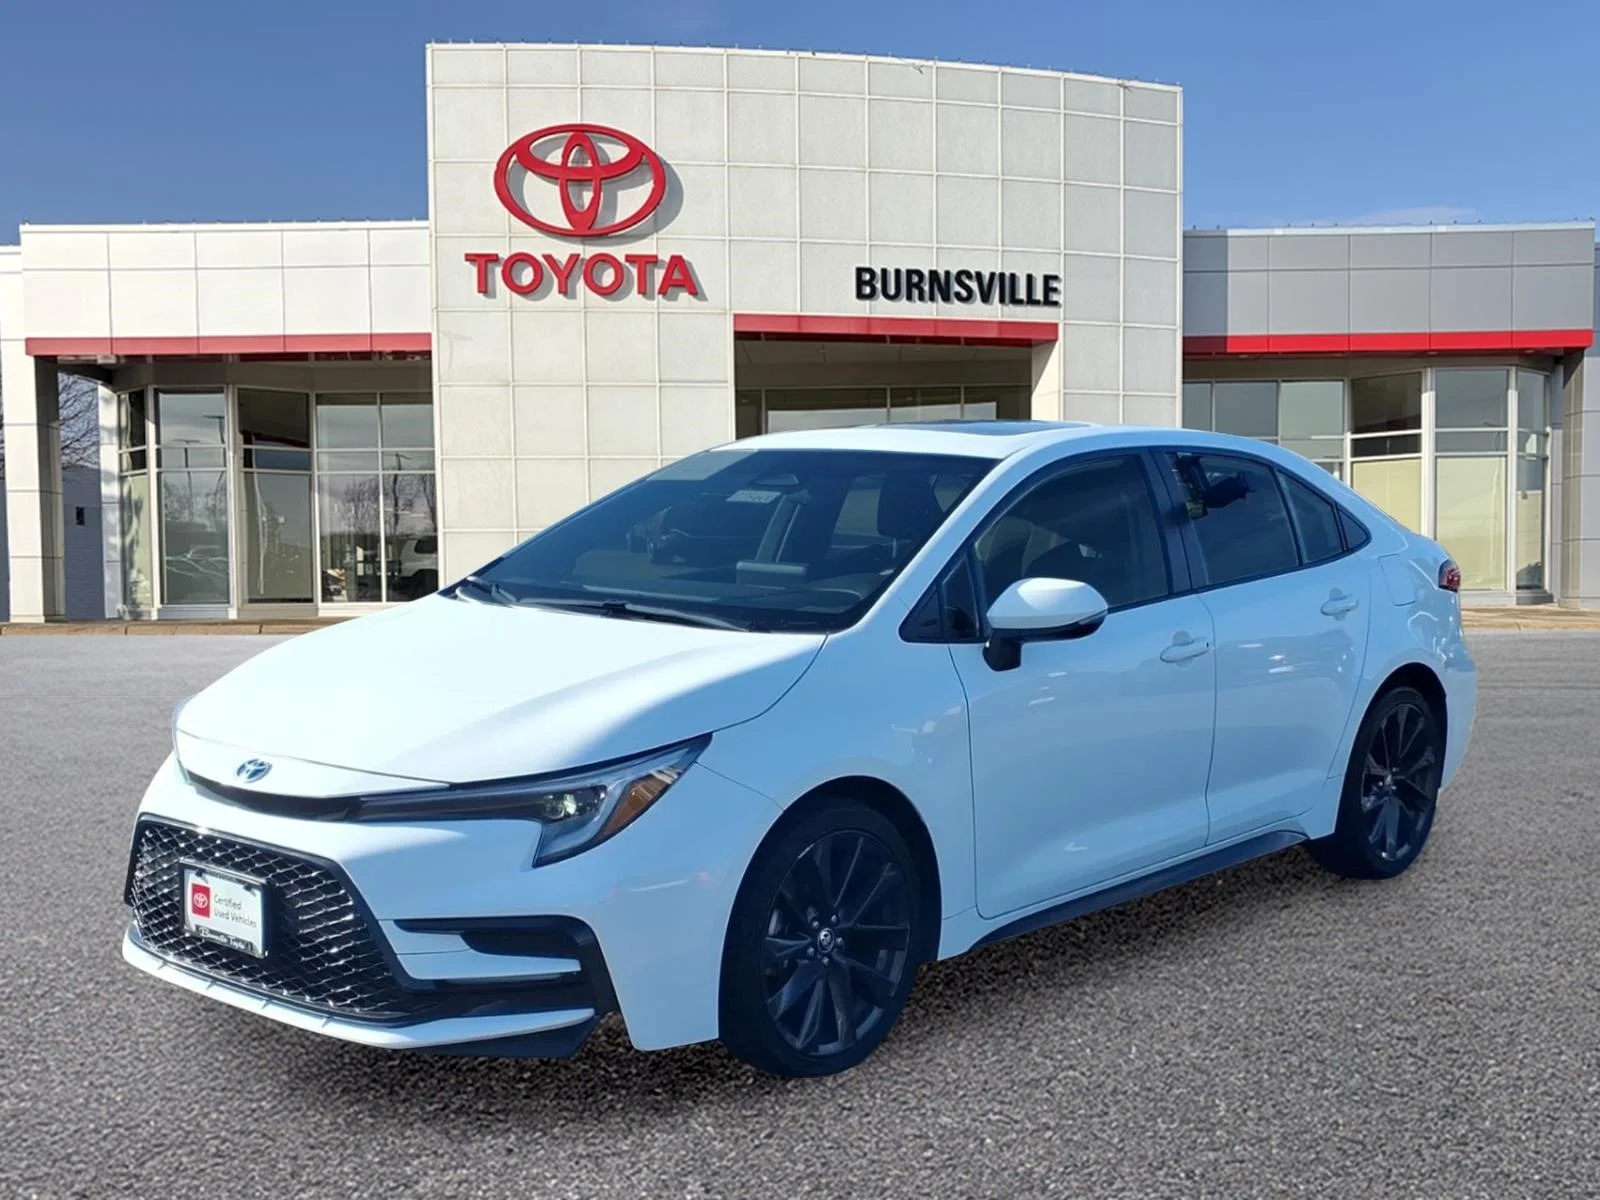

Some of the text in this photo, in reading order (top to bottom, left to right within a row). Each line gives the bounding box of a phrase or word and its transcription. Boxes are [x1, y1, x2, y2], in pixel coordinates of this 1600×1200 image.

[464, 251, 699, 297] TOYOTA
[855, 266, 1061, 306] BURNSVILLE
[214, 893, 242, 911] Certified
[214, 907, 257, 929] Used Vehicles
